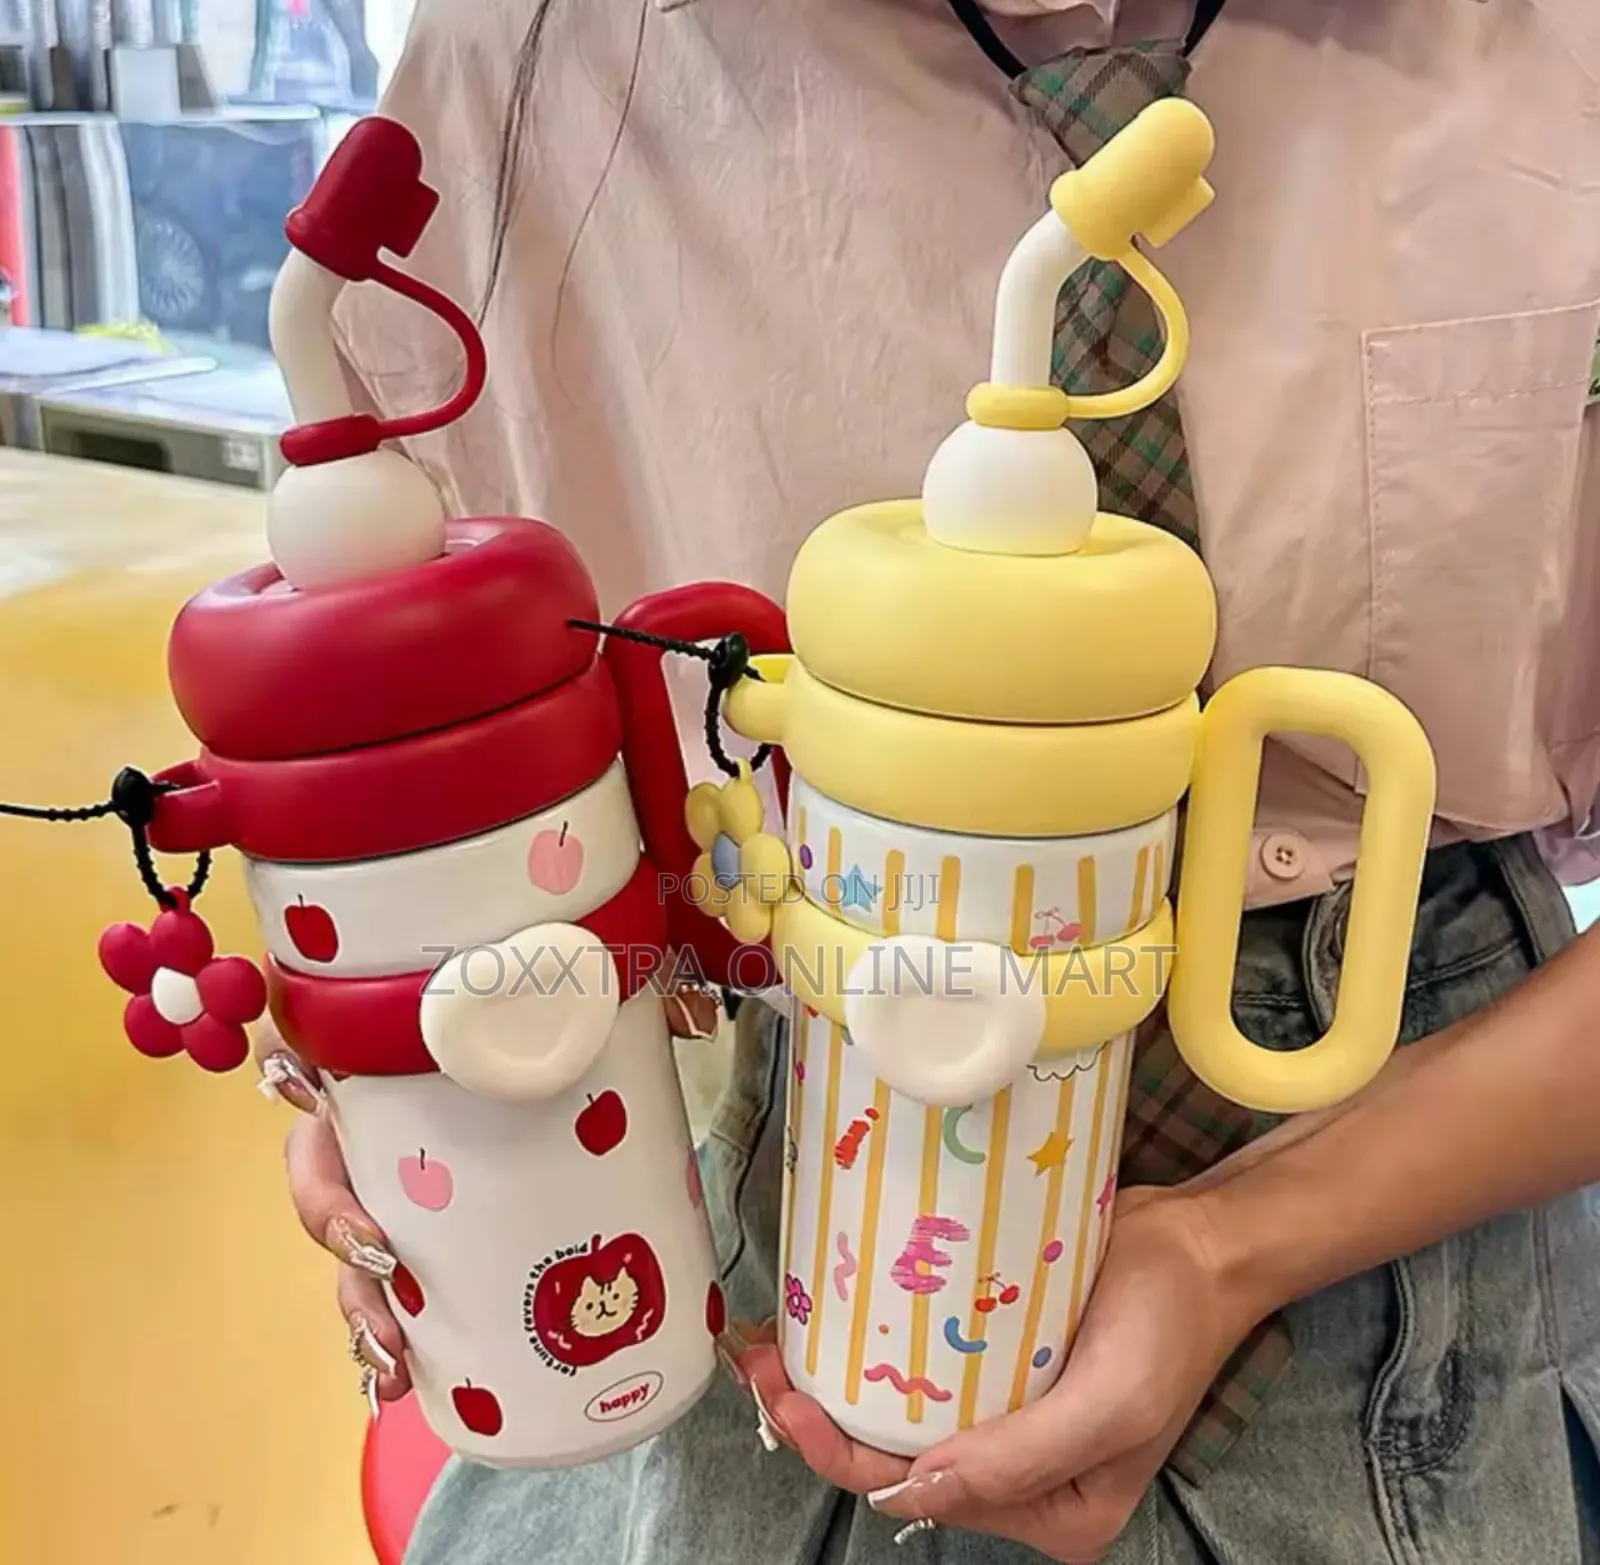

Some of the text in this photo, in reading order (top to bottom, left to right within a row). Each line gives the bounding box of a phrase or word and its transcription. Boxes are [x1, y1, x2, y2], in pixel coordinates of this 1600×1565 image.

[529, 1256, 553, 1279] the
[554, 1241, 588, 1260] bold
[599, 1382, 650, 1413] happy
